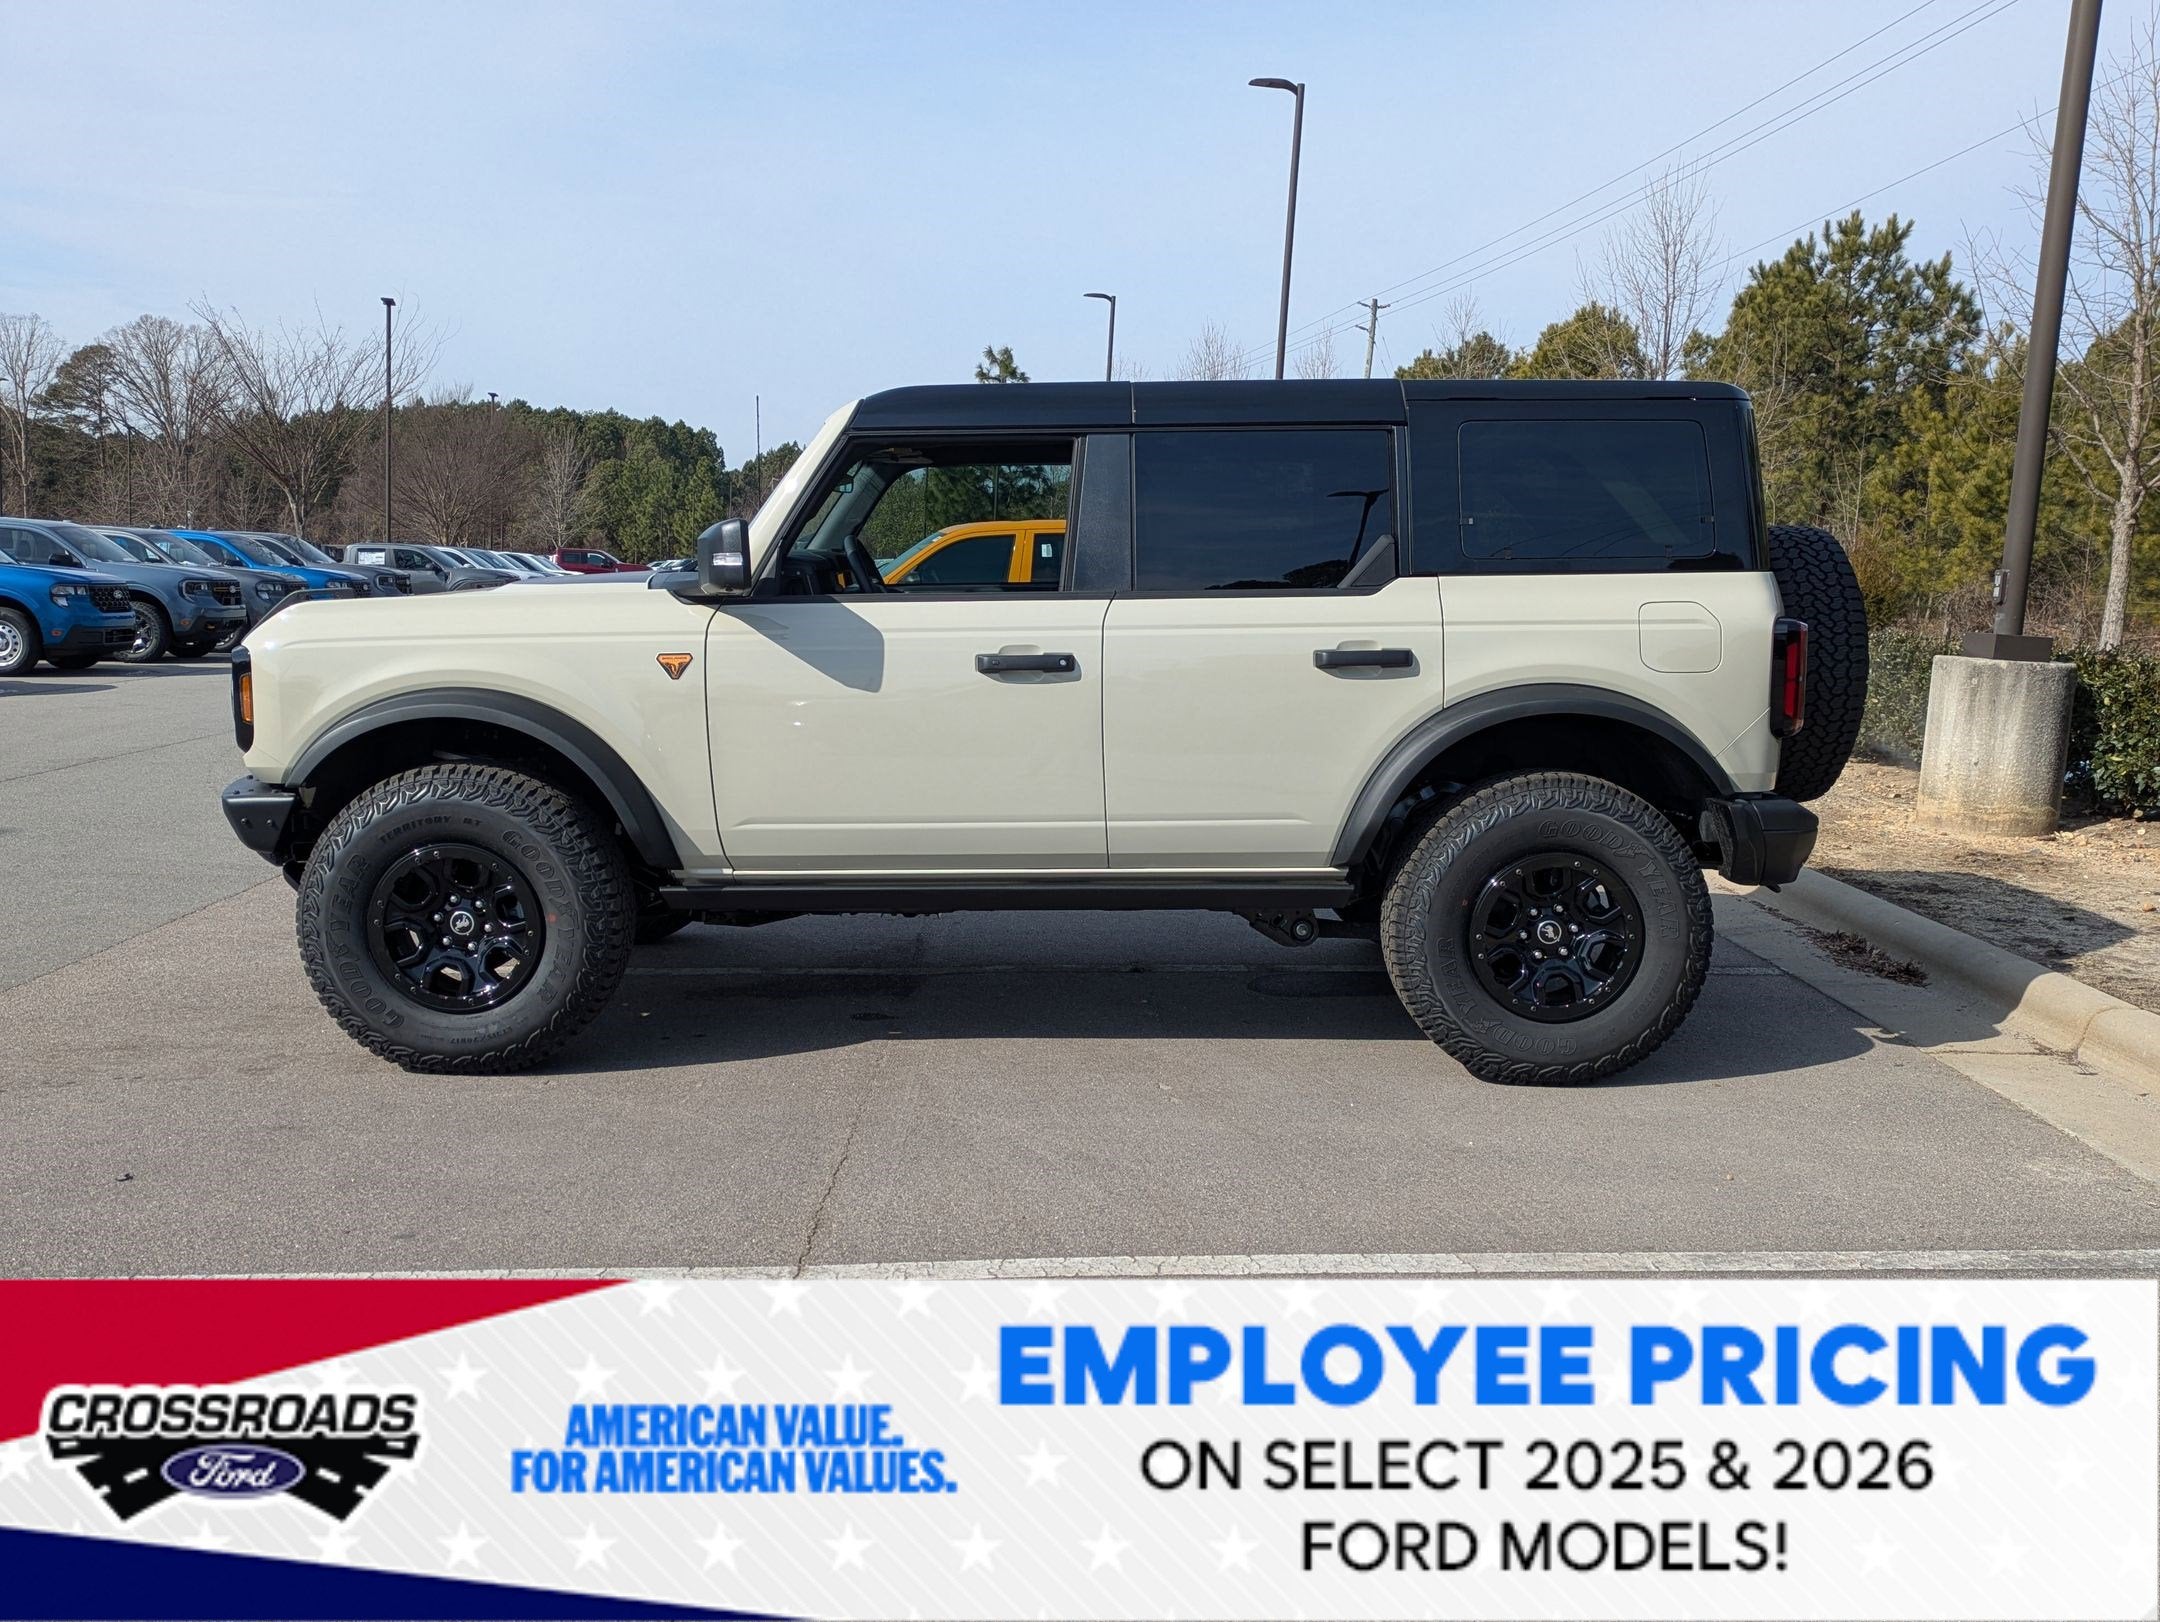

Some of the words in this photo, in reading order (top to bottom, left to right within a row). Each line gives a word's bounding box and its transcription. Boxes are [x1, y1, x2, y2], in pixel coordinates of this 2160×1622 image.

[378, 815, 452, 844] TERRITORY
[326, 854, 405, 1030] GOODYEAR
[502, 830, 581, 1007] GOODYEAR
